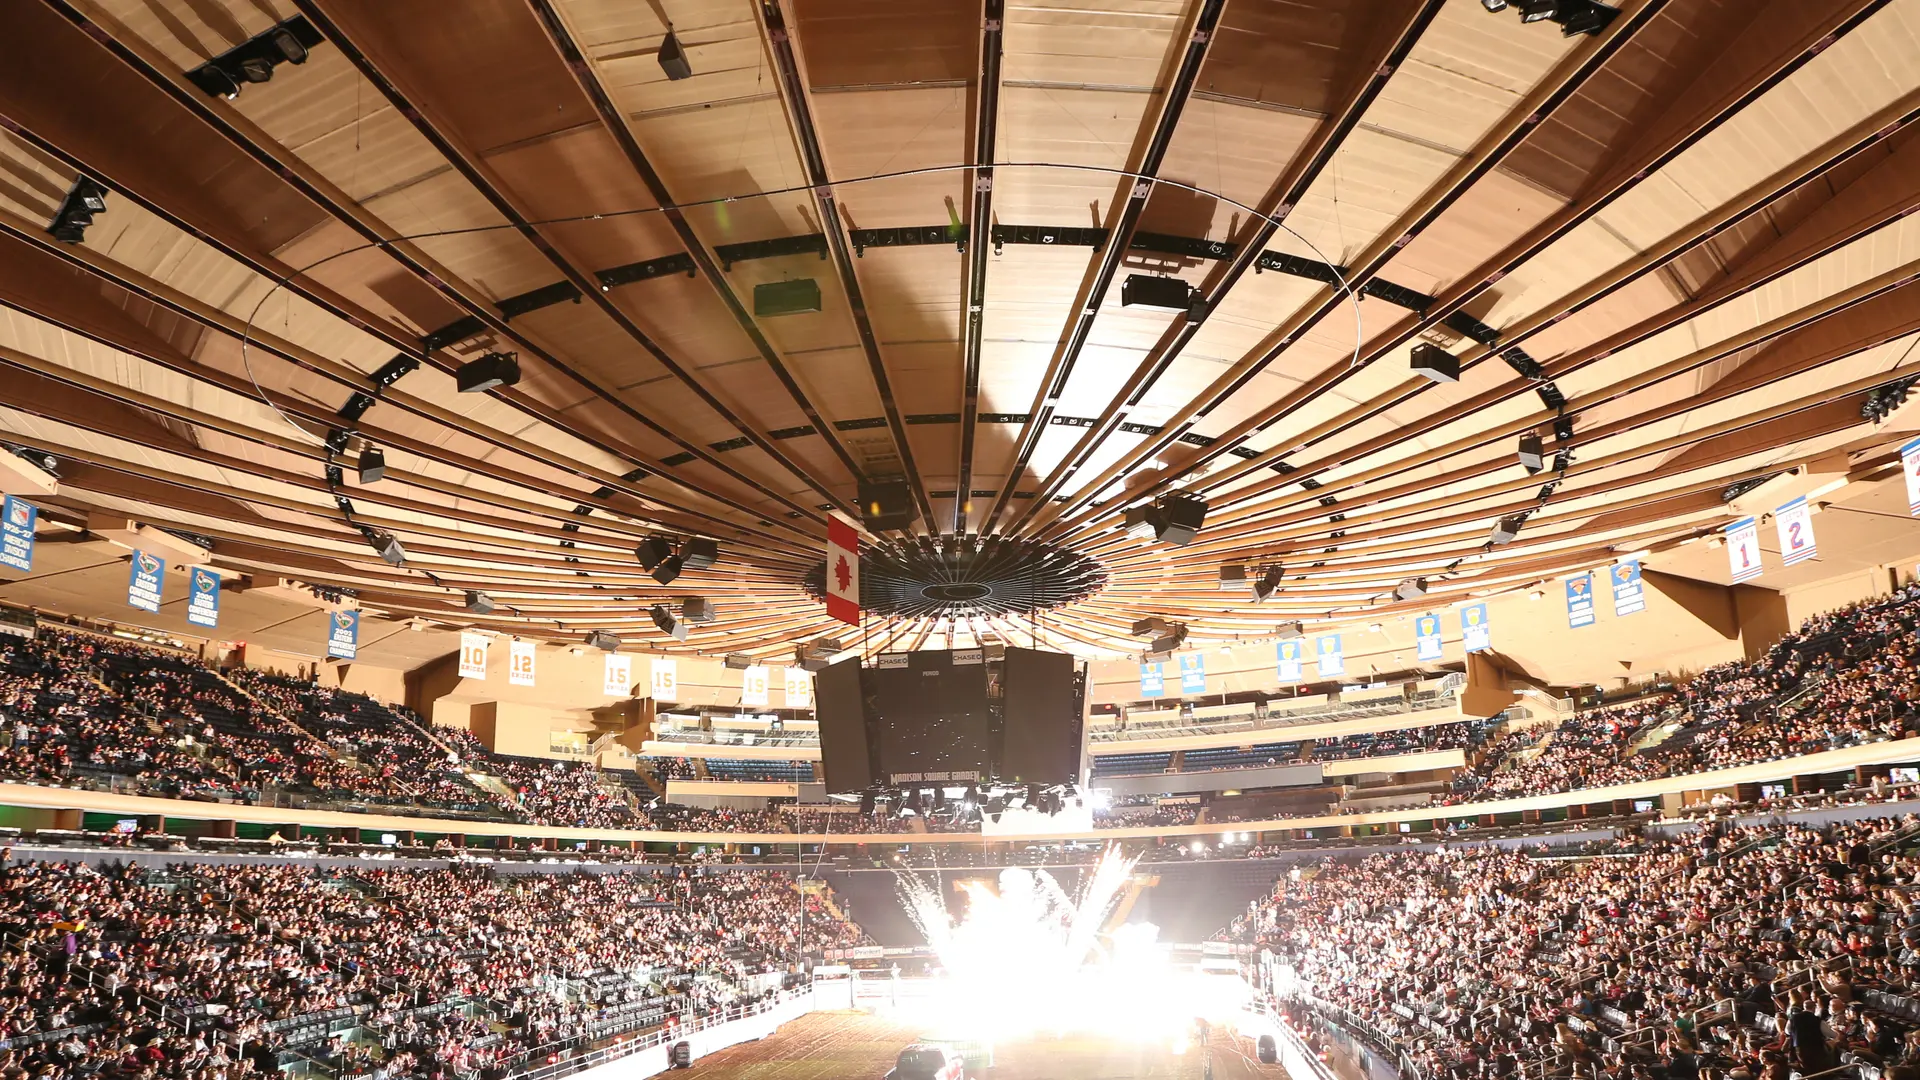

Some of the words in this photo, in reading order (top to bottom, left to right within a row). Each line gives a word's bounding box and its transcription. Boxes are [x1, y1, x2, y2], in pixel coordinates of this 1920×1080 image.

[1788, 521, 1804, 550] 2
[1740, 543, 1750, 568] 1
[195, 591, 214, 602] 2000
[335, 628, 353, 637] 2002
[463, 646, 483, 666] 10
[513, 654, 532, 673] 12
[609, 667, 627, 684] 15
[655, 671, 673, 688] 15
[747, 678, 764, 693] 19
[787, 680, 807, 695] 22
[890, 772, 922, 785] MADISON
[924, 771, 950, 782] SQUARE
[951, 771, 979, 783] GARDEN
